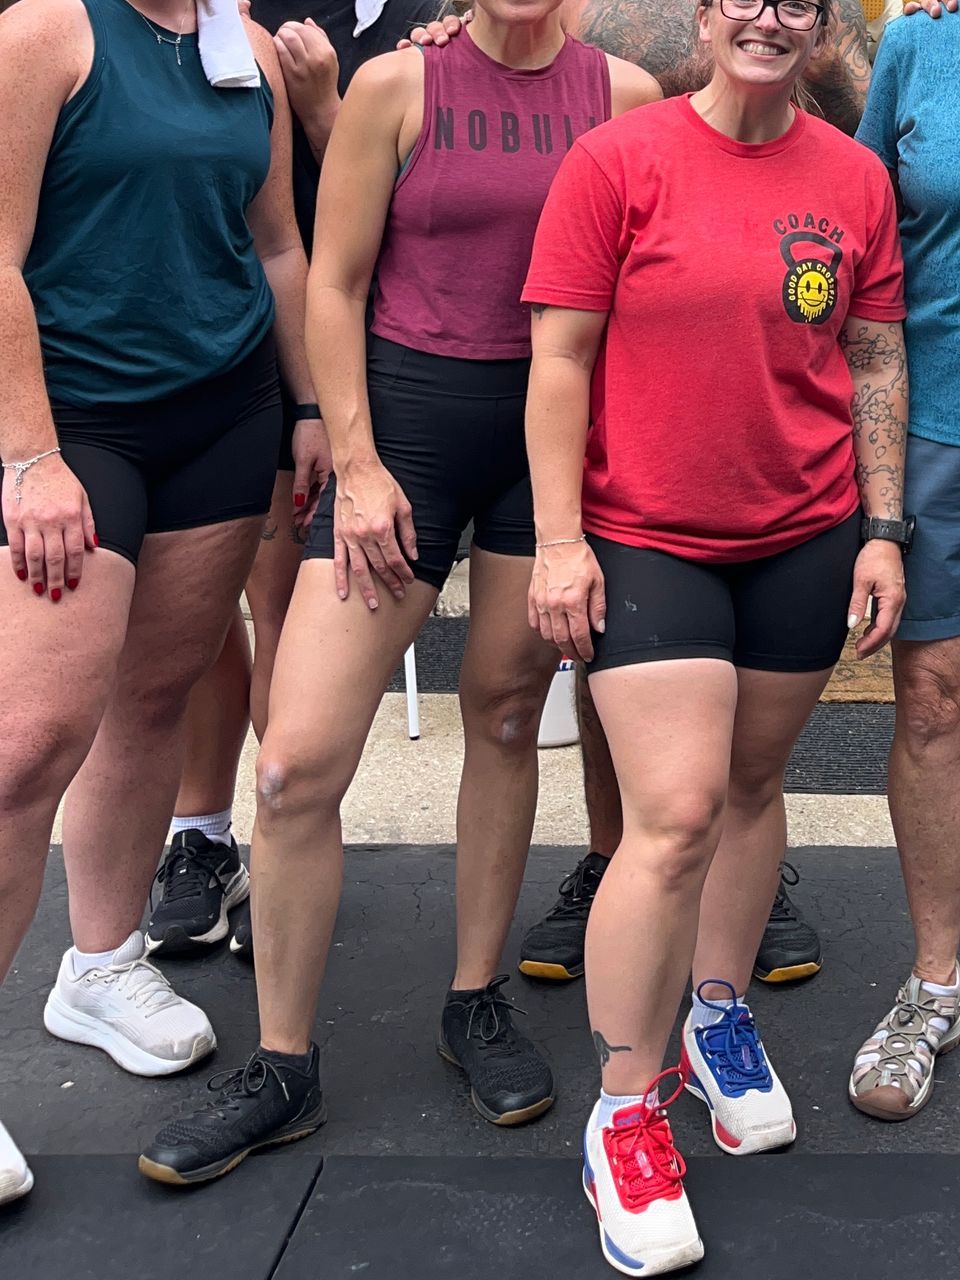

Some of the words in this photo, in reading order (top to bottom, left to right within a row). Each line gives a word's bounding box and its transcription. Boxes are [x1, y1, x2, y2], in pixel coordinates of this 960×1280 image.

[434, 106, 597, 155] NOBUL
[773, 212, 845, 244] COACH
[788, 275, 798, 301] GOOD
[796, 262, 813, 275] DAY
